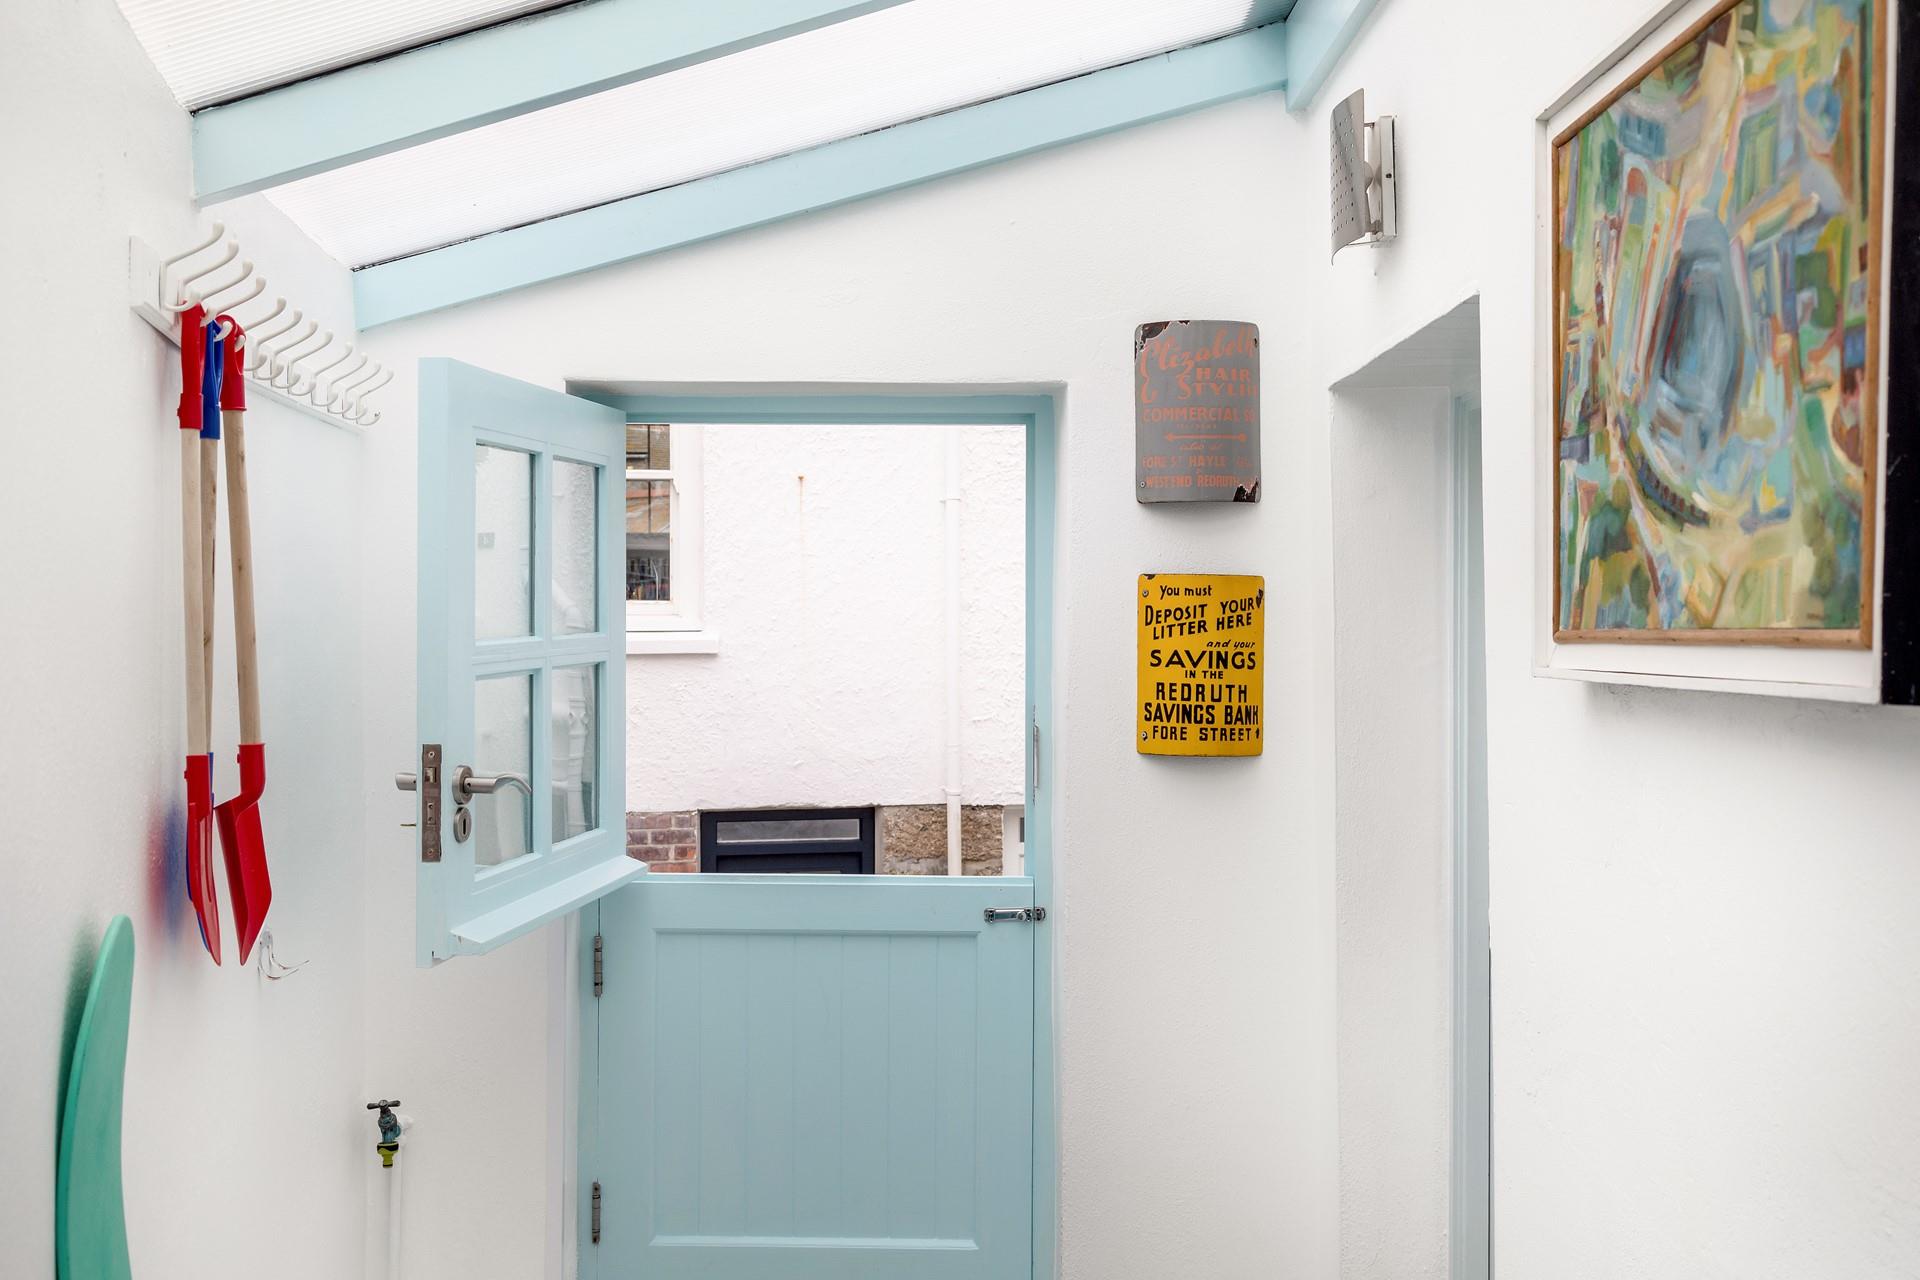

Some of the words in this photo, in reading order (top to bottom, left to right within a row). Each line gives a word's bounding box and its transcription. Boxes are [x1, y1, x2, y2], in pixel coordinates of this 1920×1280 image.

[1196, 367, 1250, 382] HAIR
[1142, 406, 1240, 423] COMMERCIAL
[1187, 455, 1227, 469] HAYLE
[1146, 475, 1170, 489] WEST
[1171, 475, 1193, 489] END
[1184, 585, 1213, 597] must
[1145, 604, 1208, 626] DEPOSIT
[1220, 597, 1255, 615] YOUR
[1153, 620, 1208, 640] LITTER
[1216, 612, 1252, 631] HERE
[1206, 639, 1231, 648] and
[1233, 640, 1256, 650] your
[1150, 649, 1256, 670] SAVINGS
[1184, 670, 1196, 679] IN
[1202, 670, 1224, 679] THE
[1156, 682, 1247, 703] REDRUTH
[1144, 702, 1215, 725] SAVINGS
[1224, 705, 1259, 726] BANK
[1152, 725, 1188, 741] FORE
[1199, 727, 1252, 742] STREET
